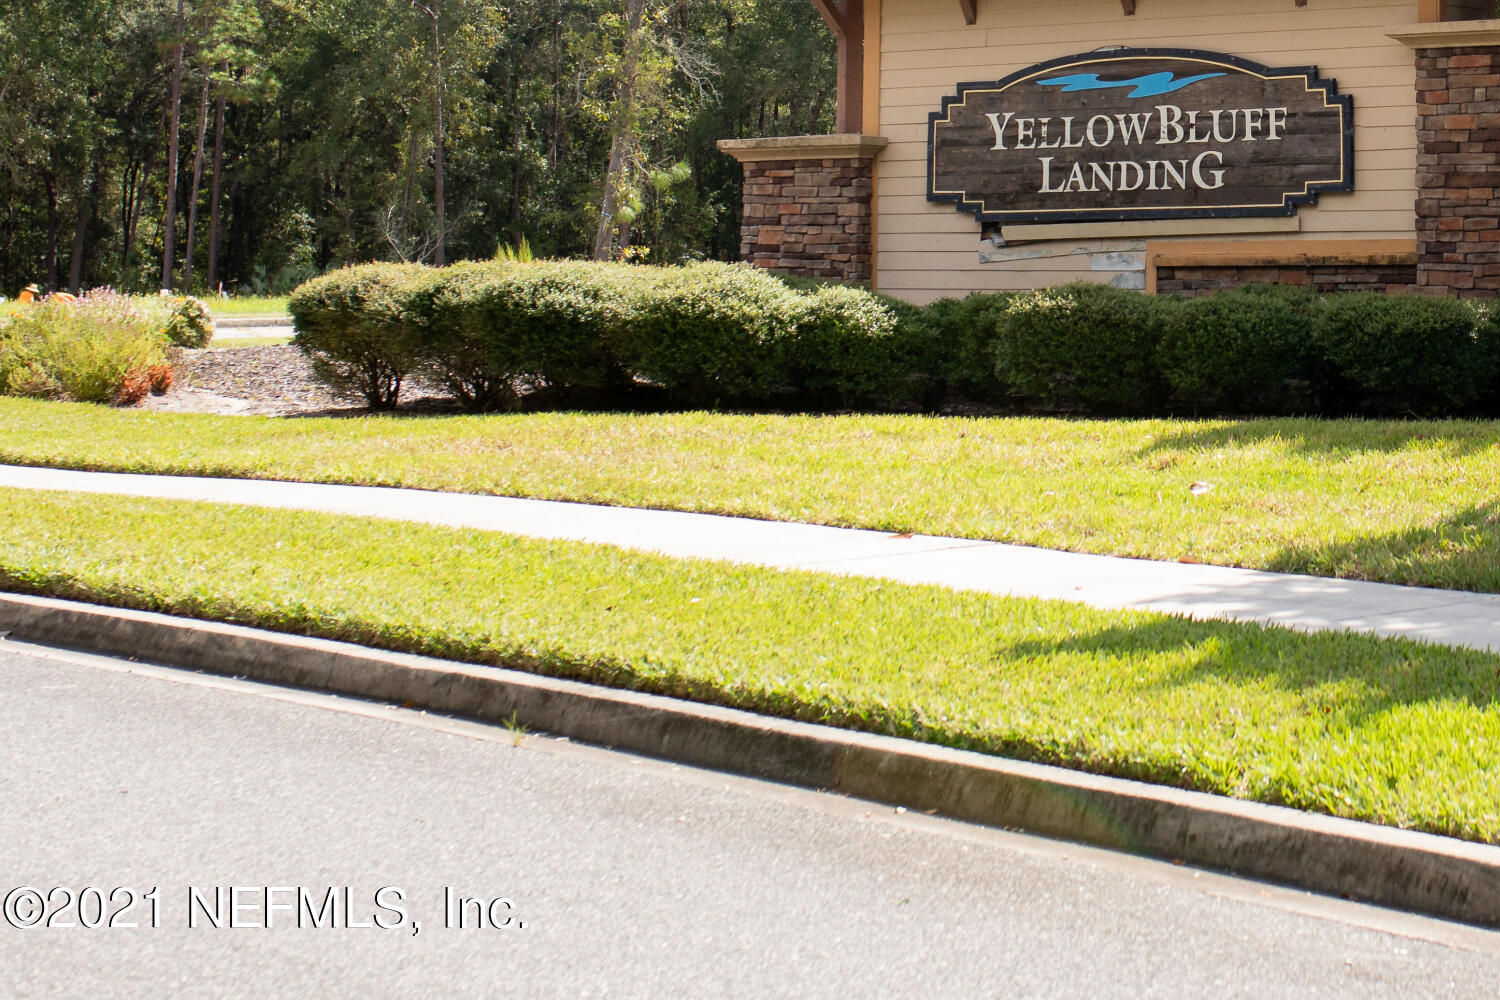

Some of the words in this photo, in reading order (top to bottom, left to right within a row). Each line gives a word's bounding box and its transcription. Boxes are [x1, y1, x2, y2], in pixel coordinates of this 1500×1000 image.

[985, 111, 1156, 151] YELLOW
[1154, 104, 1288, 145] BLUFF
[1037, 150, 1225, 193] LANDING
